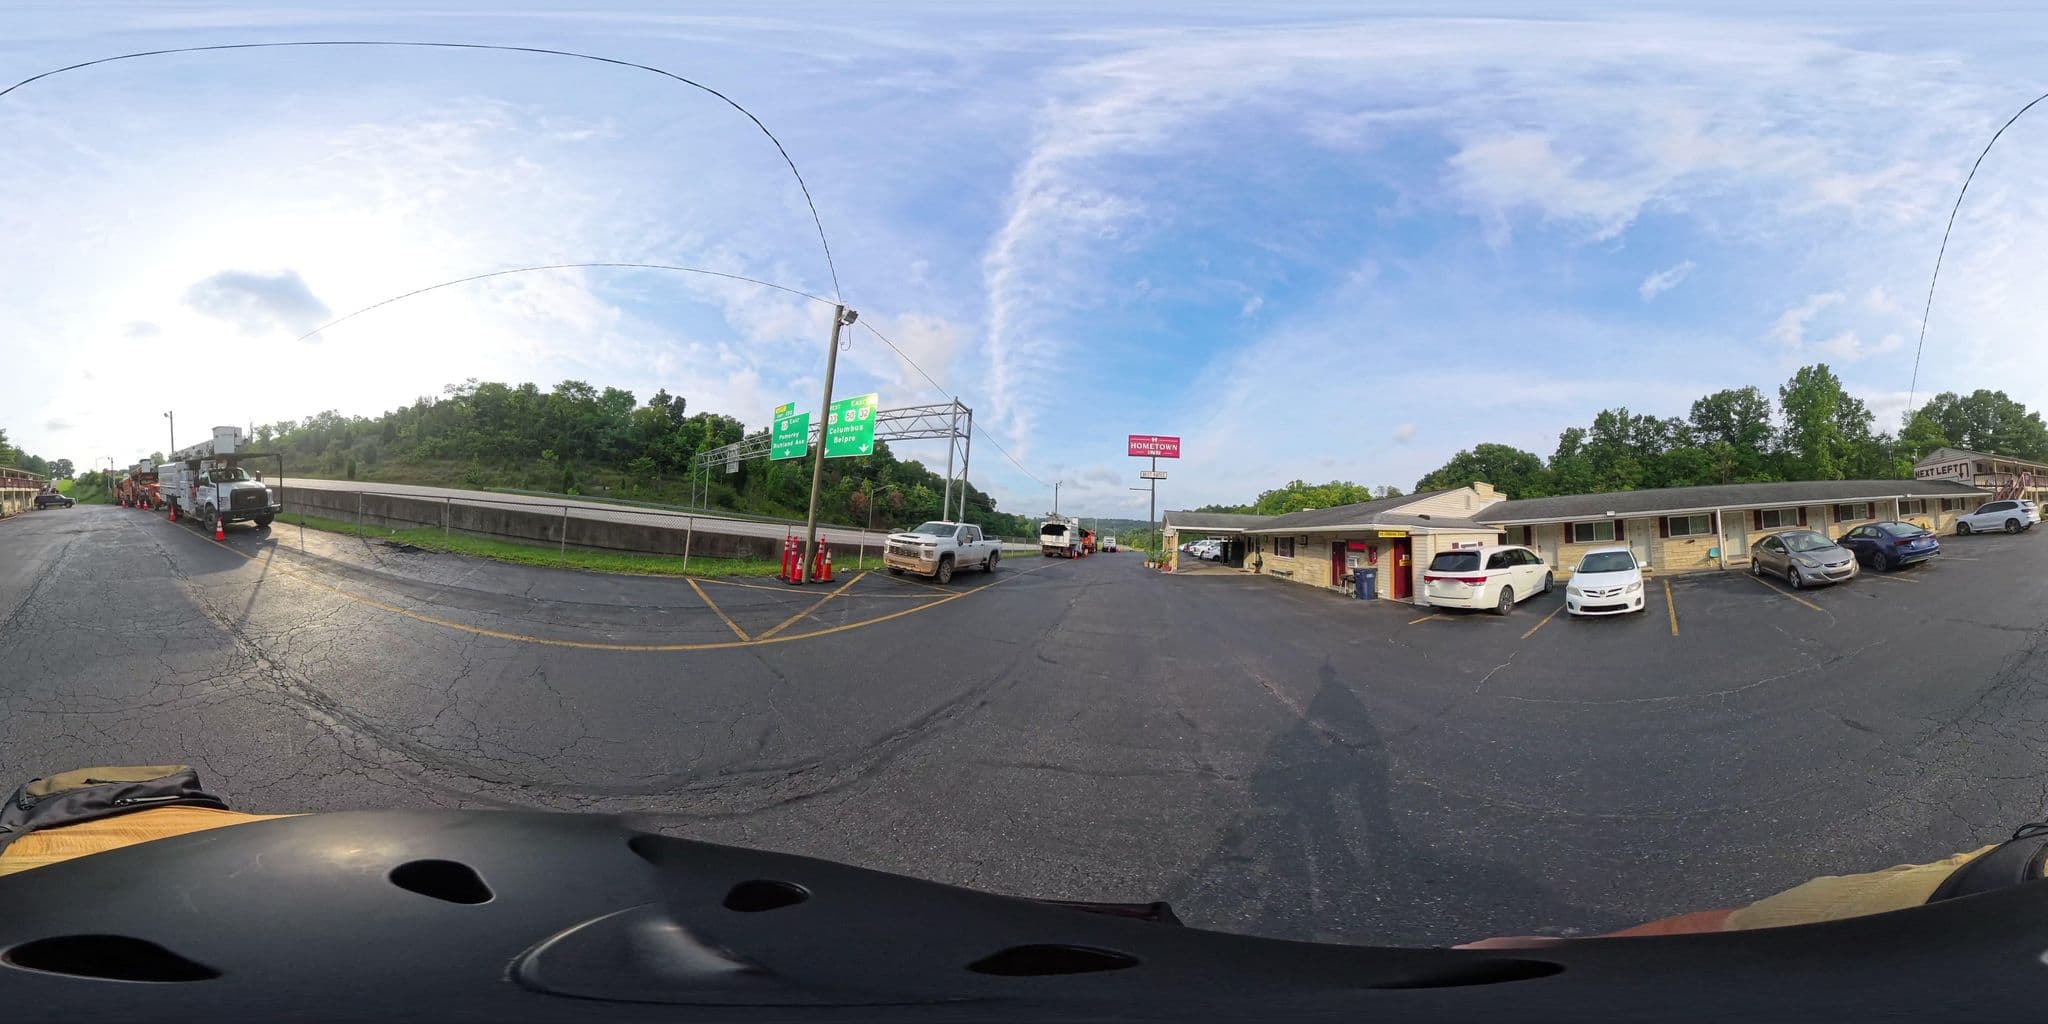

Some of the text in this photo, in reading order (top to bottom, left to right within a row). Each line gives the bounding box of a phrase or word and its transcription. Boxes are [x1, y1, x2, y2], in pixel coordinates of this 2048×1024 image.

[847, 412, 854, 420] 50
[830, 425, 864, 434] Columbus
[1936, 464, 1958, 475] LEFT
